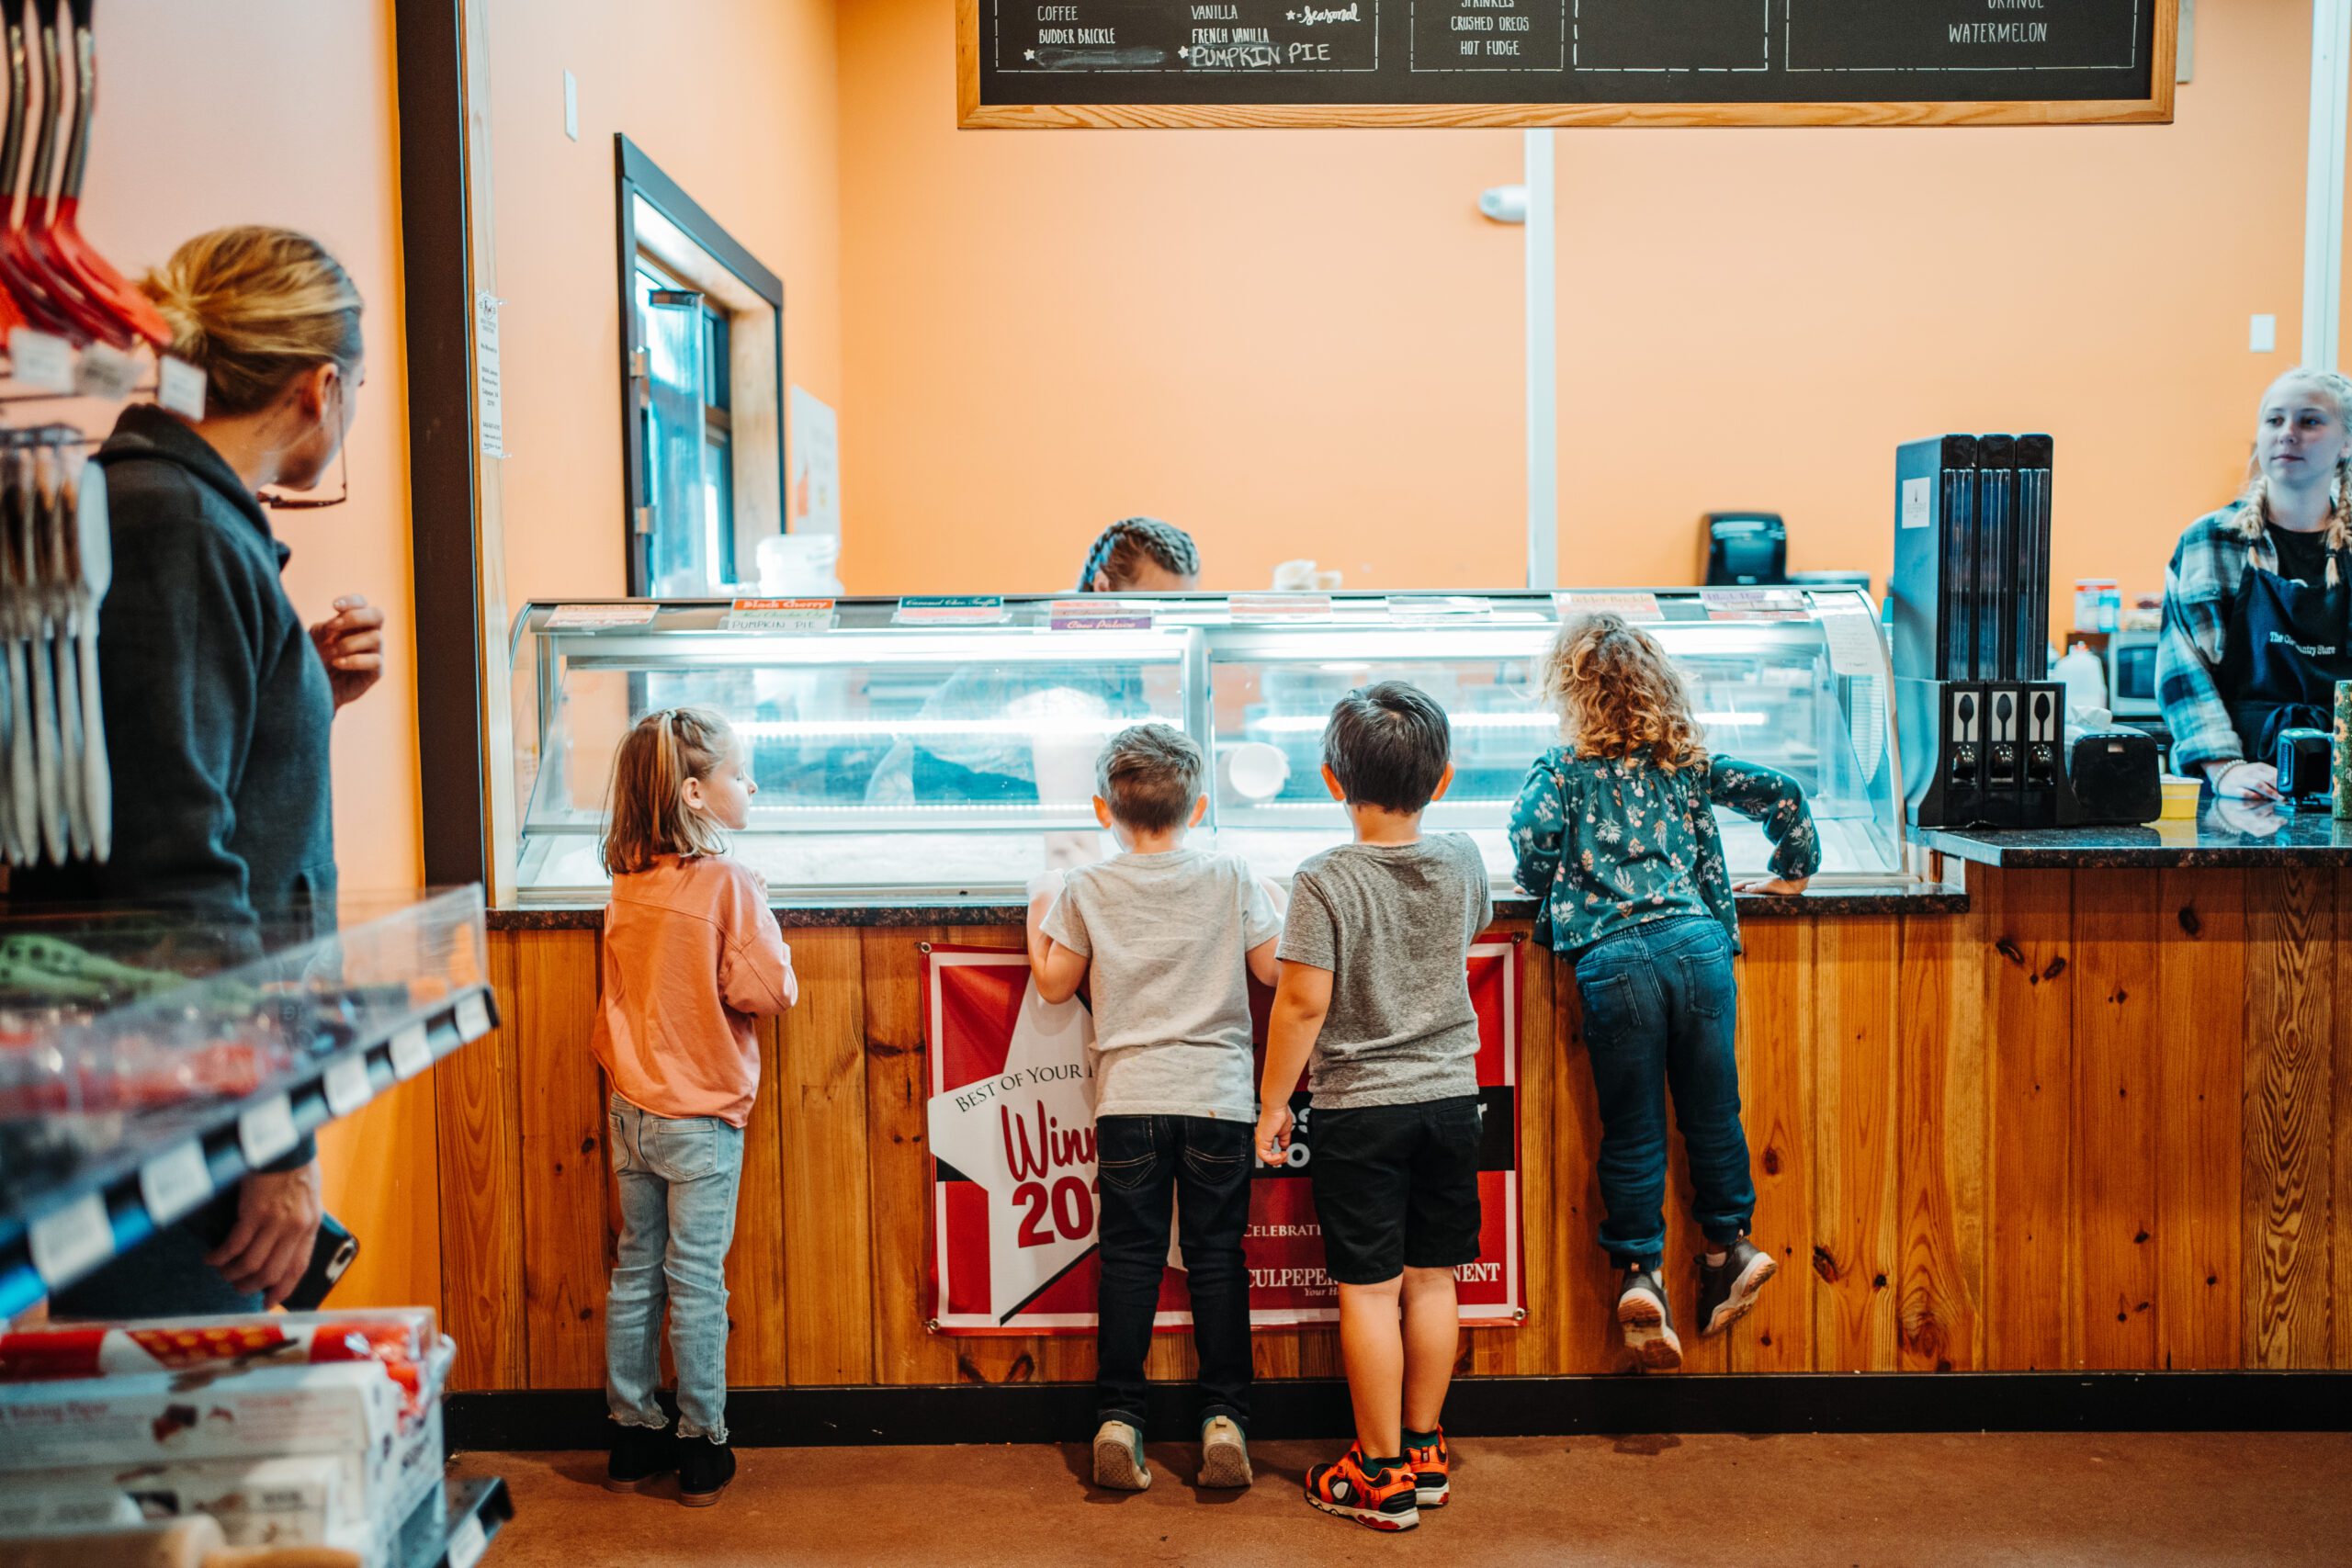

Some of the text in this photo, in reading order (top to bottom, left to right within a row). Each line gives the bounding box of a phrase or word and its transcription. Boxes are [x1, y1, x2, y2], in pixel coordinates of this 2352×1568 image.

[1037, 6, 1079, 21] COFFEE
[1191, 5, 1238, 20] VANILLA
[1451, 16, 1529, 30] CRUSHED OREOS
[1038, 28, 1116, 44] BUDDER BRICKLE
[1192, 28, 1269, 44] FRENCH VANILLA
[1949, 22, 2047, 43] WATERMELON
[1193, 42, 1331, 67] PUMPKIN PIE
[1460, 40, 1521, 55] HOT FUDGE
[742, 599, 828, 610] Black Cherry
[731, 620, 815, 629] PUMPKIN PIE
[2269, 631, 2284, 643] The
[2317, 645, 2336, 655] Store
[956, 1081, 996, 1112] BEST
[1001, 1073, 1023, 1090] OF
[1026, 1064, 1083, 1084] YOUR
[1012, 1176, 1100, 1248] 20
[1305, 1287, 1327, 1296] Your
